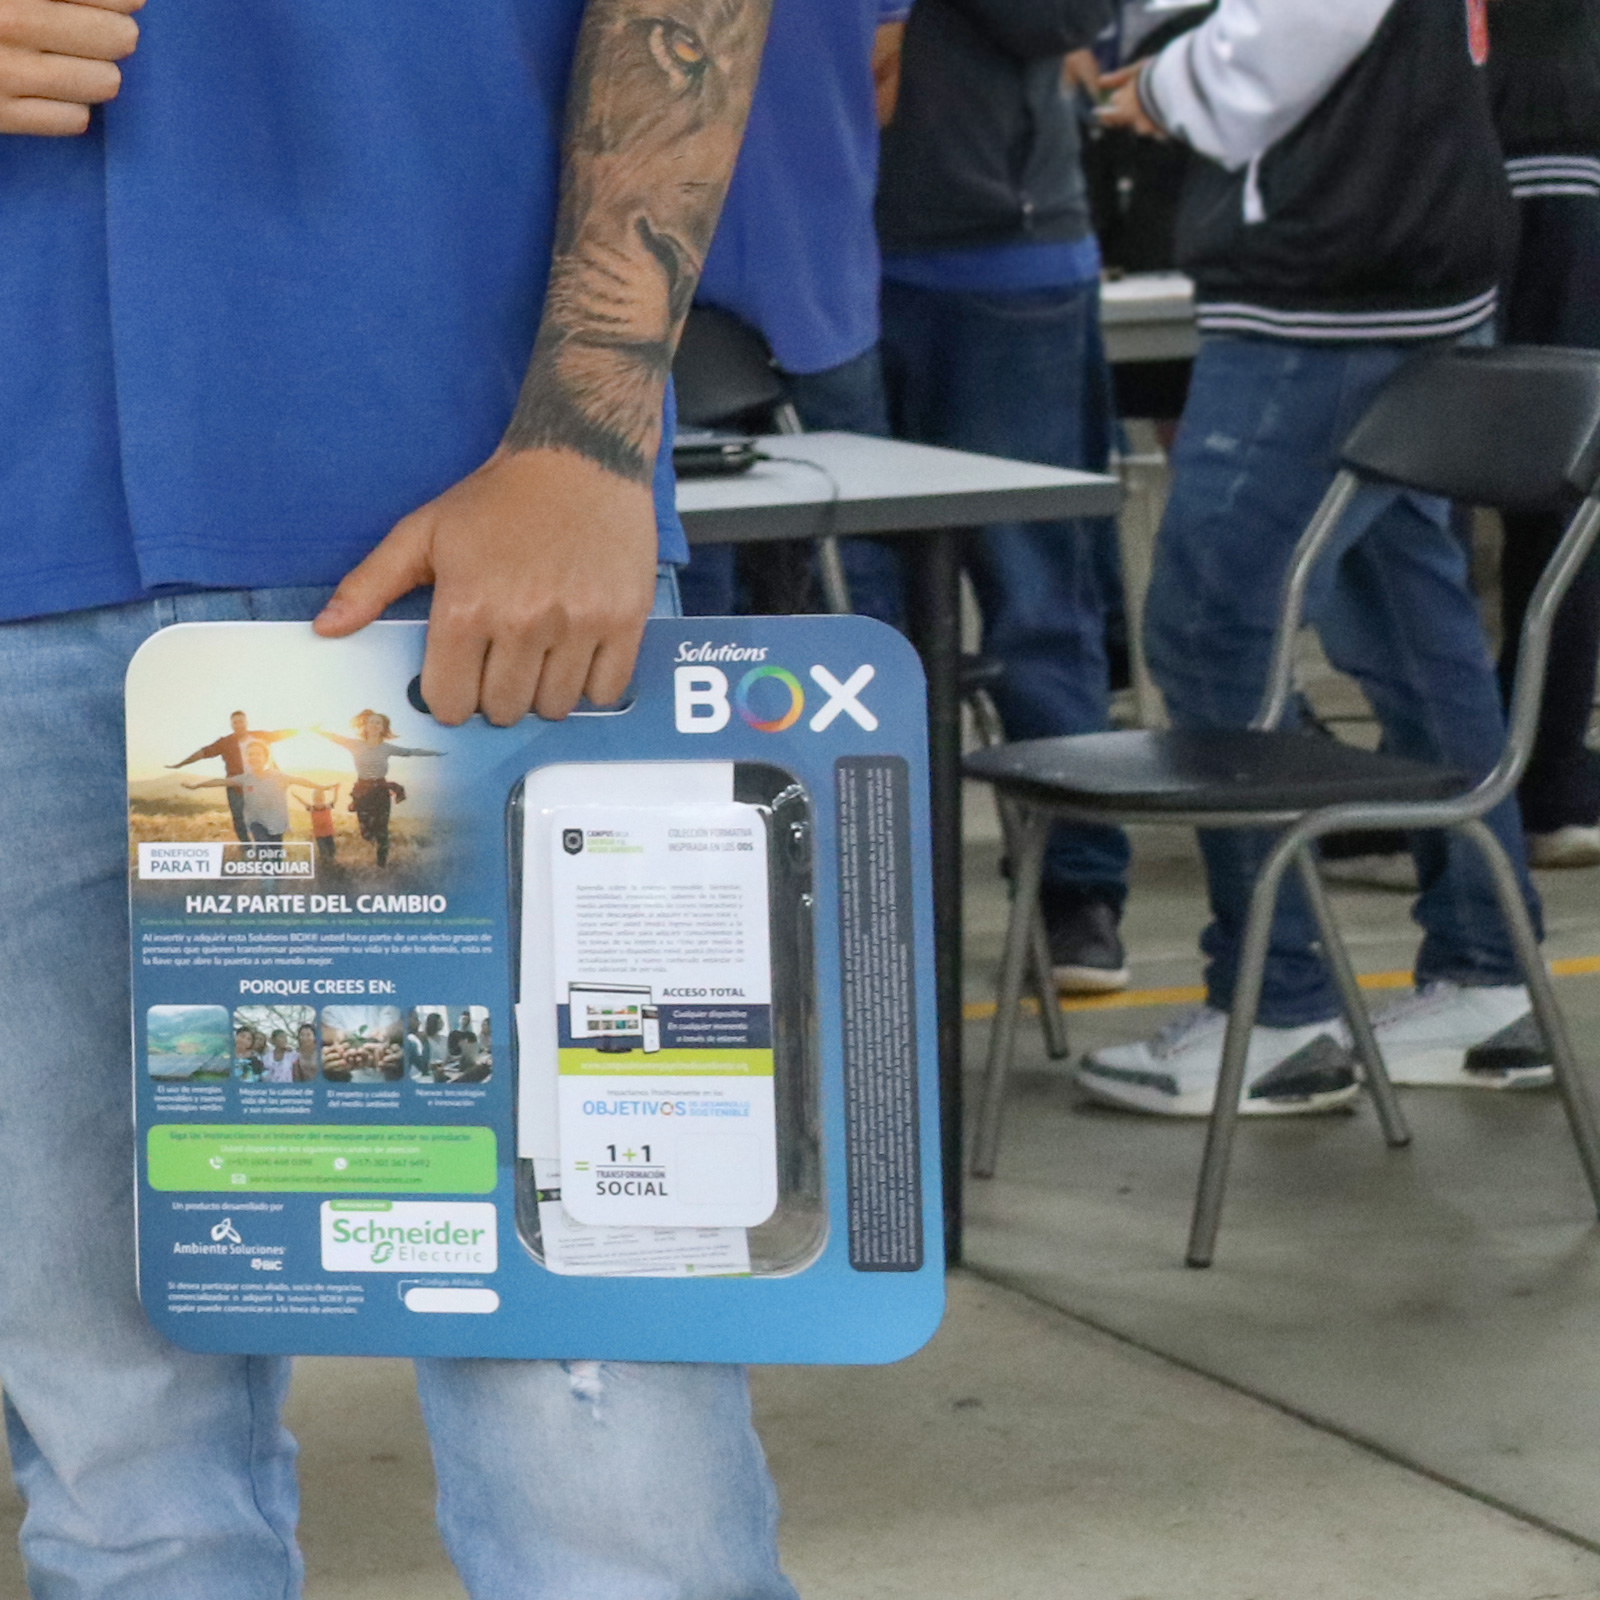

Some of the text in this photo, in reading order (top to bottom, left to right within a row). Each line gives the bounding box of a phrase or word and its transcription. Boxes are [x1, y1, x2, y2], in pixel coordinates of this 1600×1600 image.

[674, 641, 769, 663] Solutions
[674, 664, 879, 734] BOX
[151, 849, 209, 858] BENEFICIOS
[259, 849, 287, 860] para
[150, 860, 210, 873] PARA TI
[224, 861, 310, 875] OBSEQUIAR
[186, 895, 447, 913] HAZ PARTE DEL CAMBIO
[239, 979, 396, 996] PORQUE CREES EN:
[662, 988, 746, 997] ACCESO TOTAL
[582, 1100, 687, 1116] OBJETIVOS
[596, 1181, 668, 1196] SOCIAL
[185, 1202, 220, 1211] producto
[332, 1218, 485, 1245] Schneider
[173, 1242, 284, 1255] Ambiente Soluciones
[398, 1246, 483, 1263] Electric
